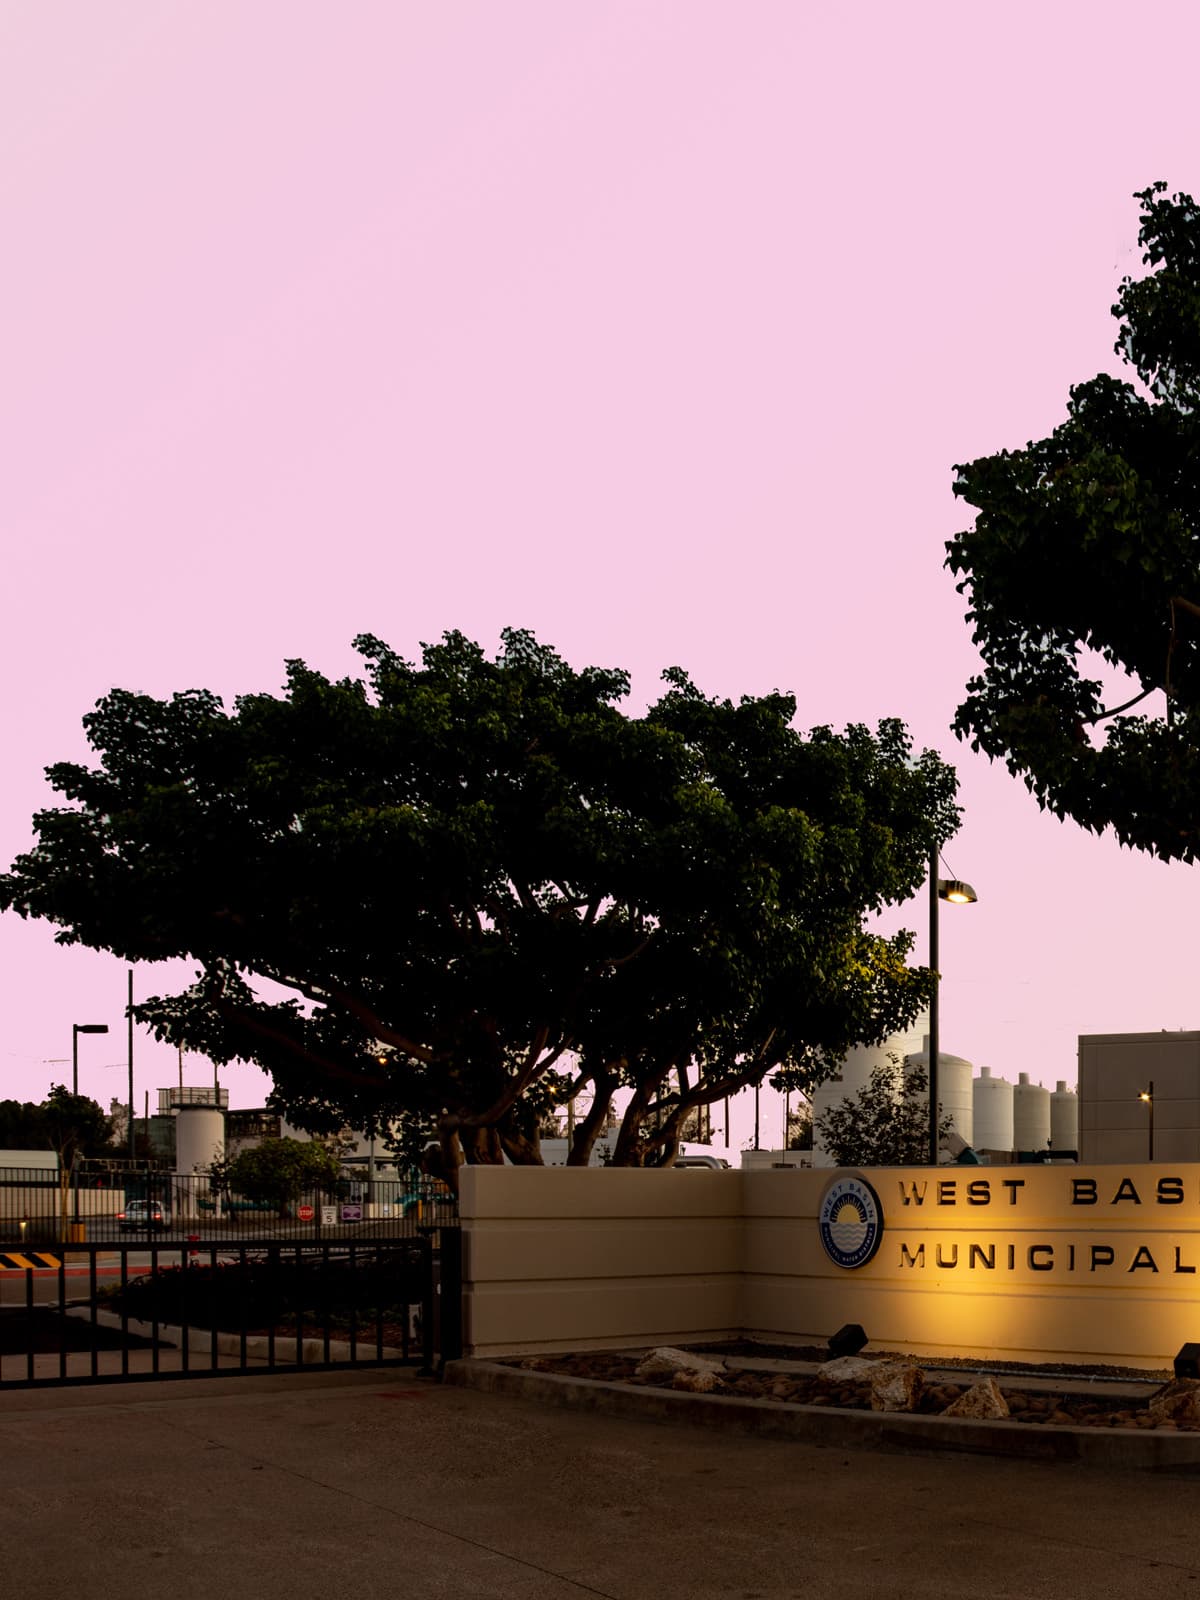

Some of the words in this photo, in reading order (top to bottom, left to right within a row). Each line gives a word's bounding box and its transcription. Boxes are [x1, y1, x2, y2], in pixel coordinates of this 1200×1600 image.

[823, 1184, 842, 1218] WEST
[898, 1179, 1026, 1207] WEST
[326, 1215, 333, 1223] 5
[899, 1243, 1197, 1274] MUNICIPAL
